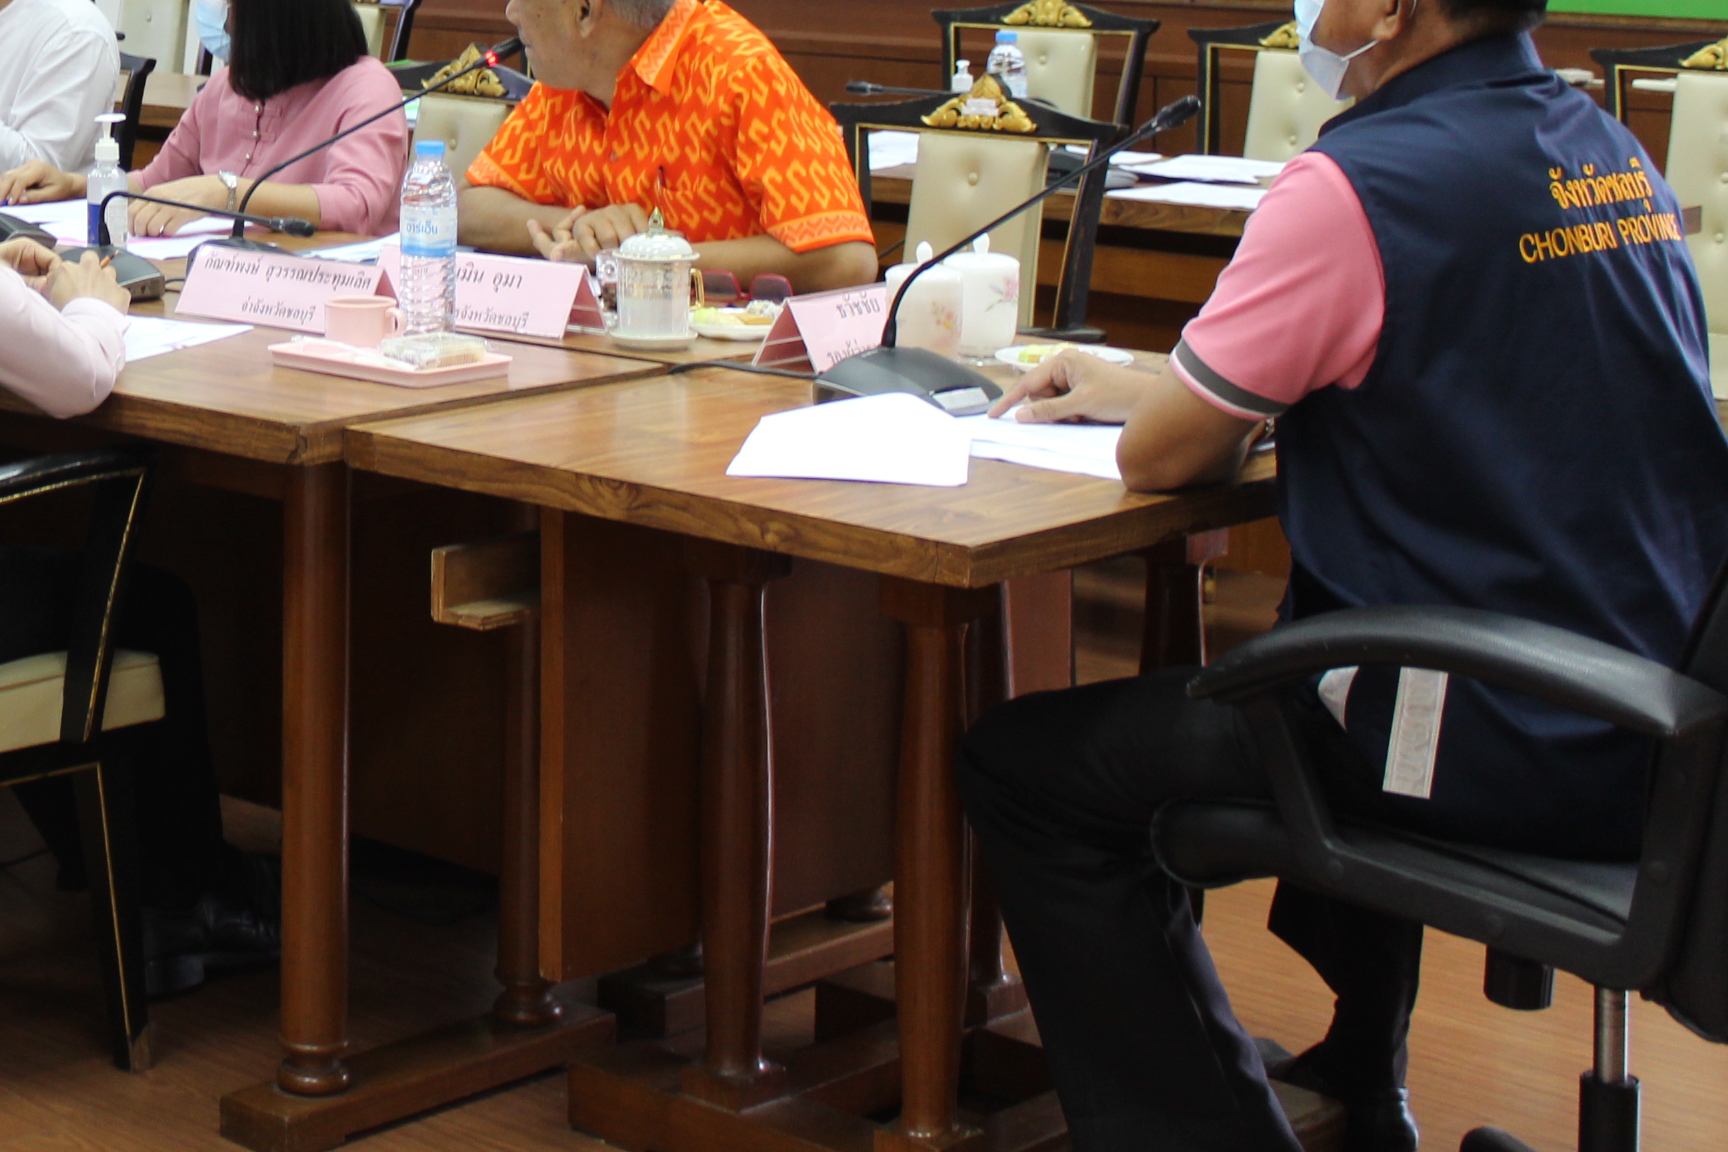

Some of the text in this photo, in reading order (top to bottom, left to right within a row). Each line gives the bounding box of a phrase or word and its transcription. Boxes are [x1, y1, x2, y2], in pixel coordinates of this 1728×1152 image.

[1549, 157, 1654, 211] จังหวัดชลบุรี
[406, 221, 438, 235] อาร์เอ็น
[1519, 213, 1681, 263] CHONBURI PROVINCE
